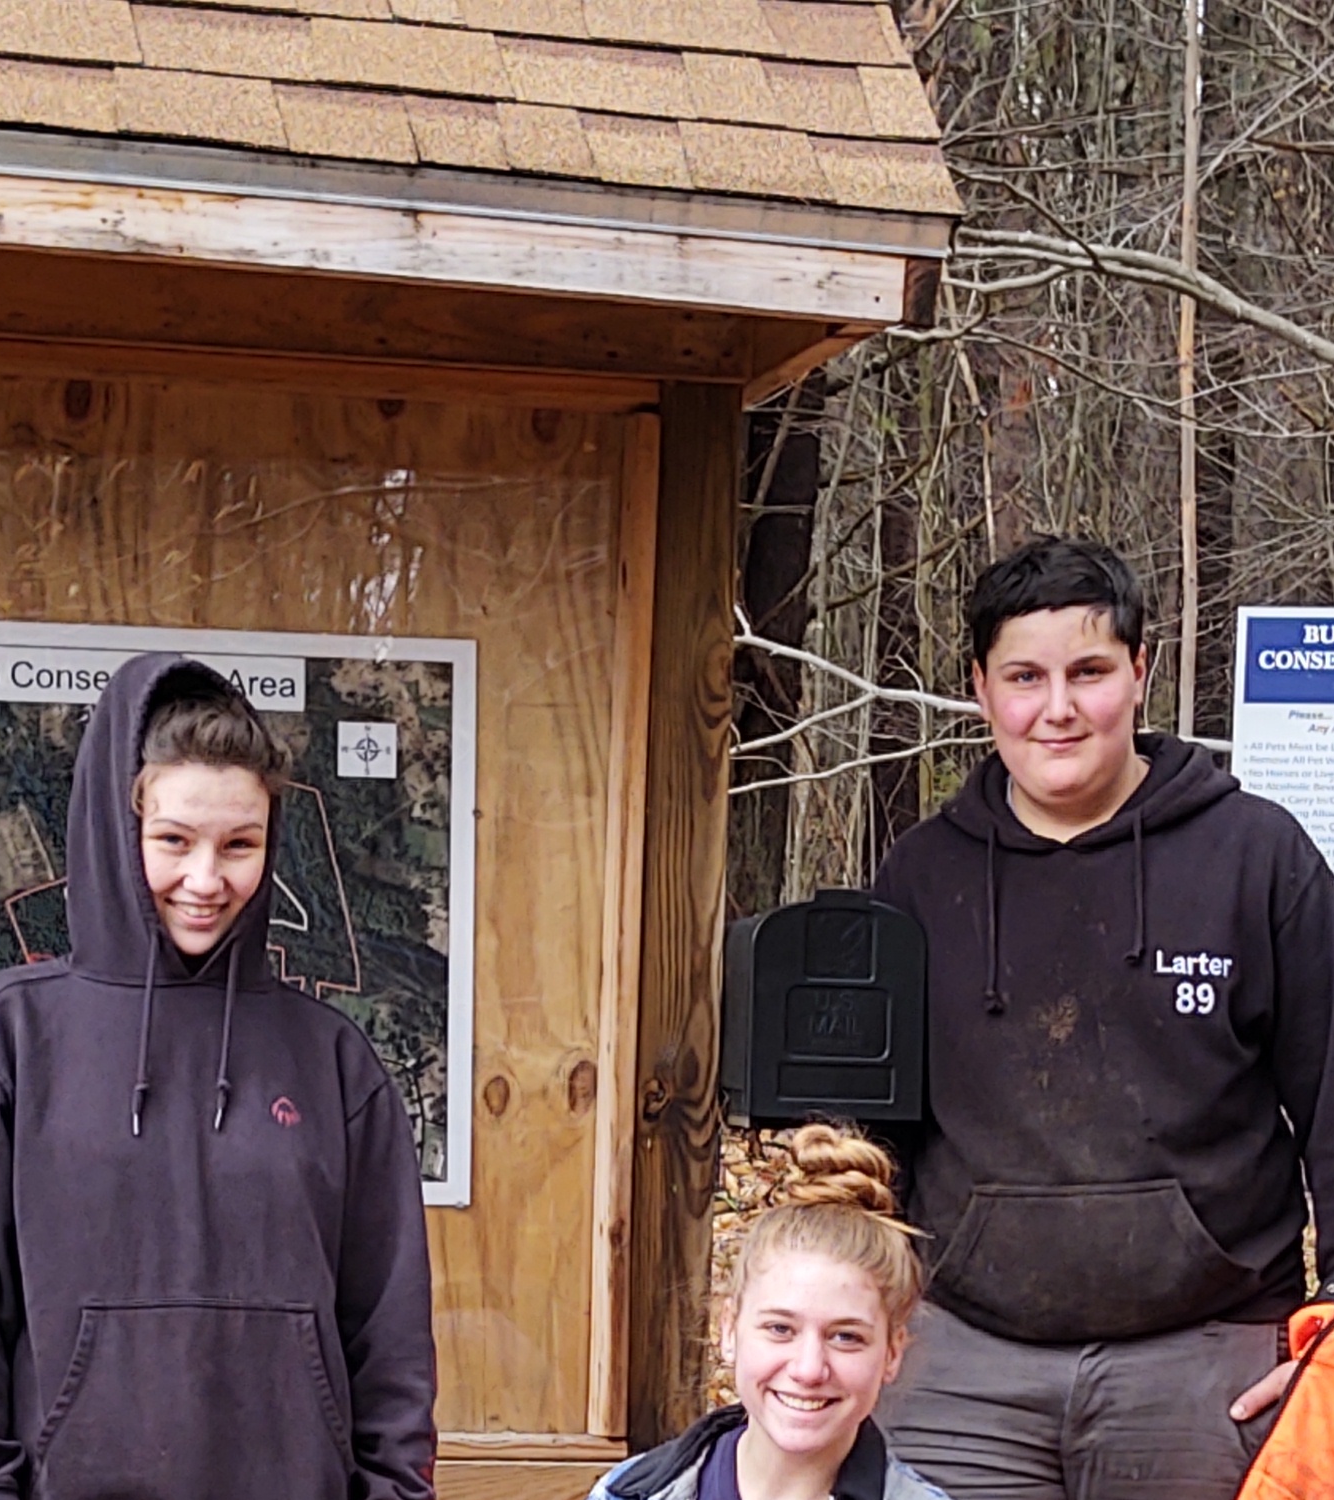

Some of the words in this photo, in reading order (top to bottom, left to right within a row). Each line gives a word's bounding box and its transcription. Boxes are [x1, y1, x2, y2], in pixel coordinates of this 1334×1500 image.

[11, 660, 111, 691] Conse
[228, 668, 296, 698] Area
[1308, 723, 1329, 735] Any
[1156, 949, 1233, 978] Larter
[1175, 982, 1216, 1015] 89
[809, 1015, 863, 1035] MAIL
